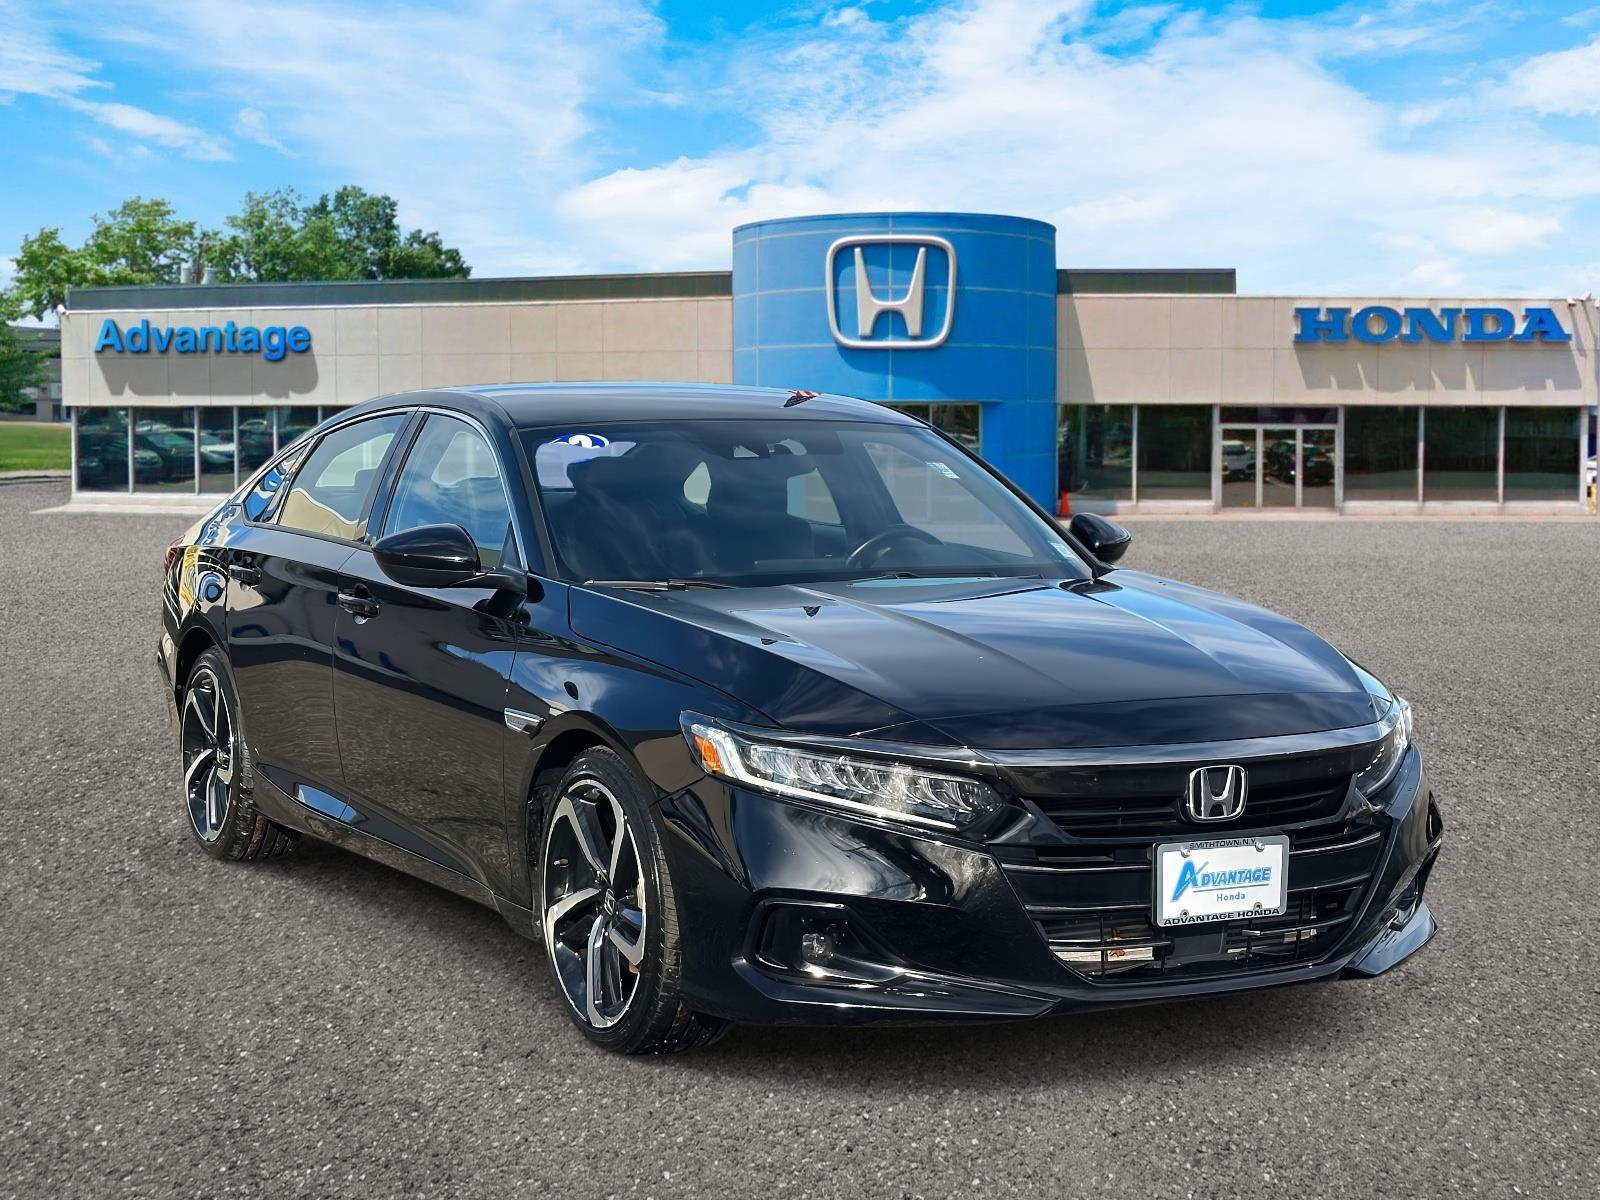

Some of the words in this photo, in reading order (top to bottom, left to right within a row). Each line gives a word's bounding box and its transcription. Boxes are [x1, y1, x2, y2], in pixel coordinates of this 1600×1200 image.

[96, 319, 311, 361] Advantage
[1294, 306, 1572, 344] HONDA
[1171, 860, 1272, 902] ADVANTAGE
[1216, 892, 1246, 902] Honda
[1163, 911, 1234, 926] ADVANTAGE
[1237, 908, 1280, 918] HONDA
